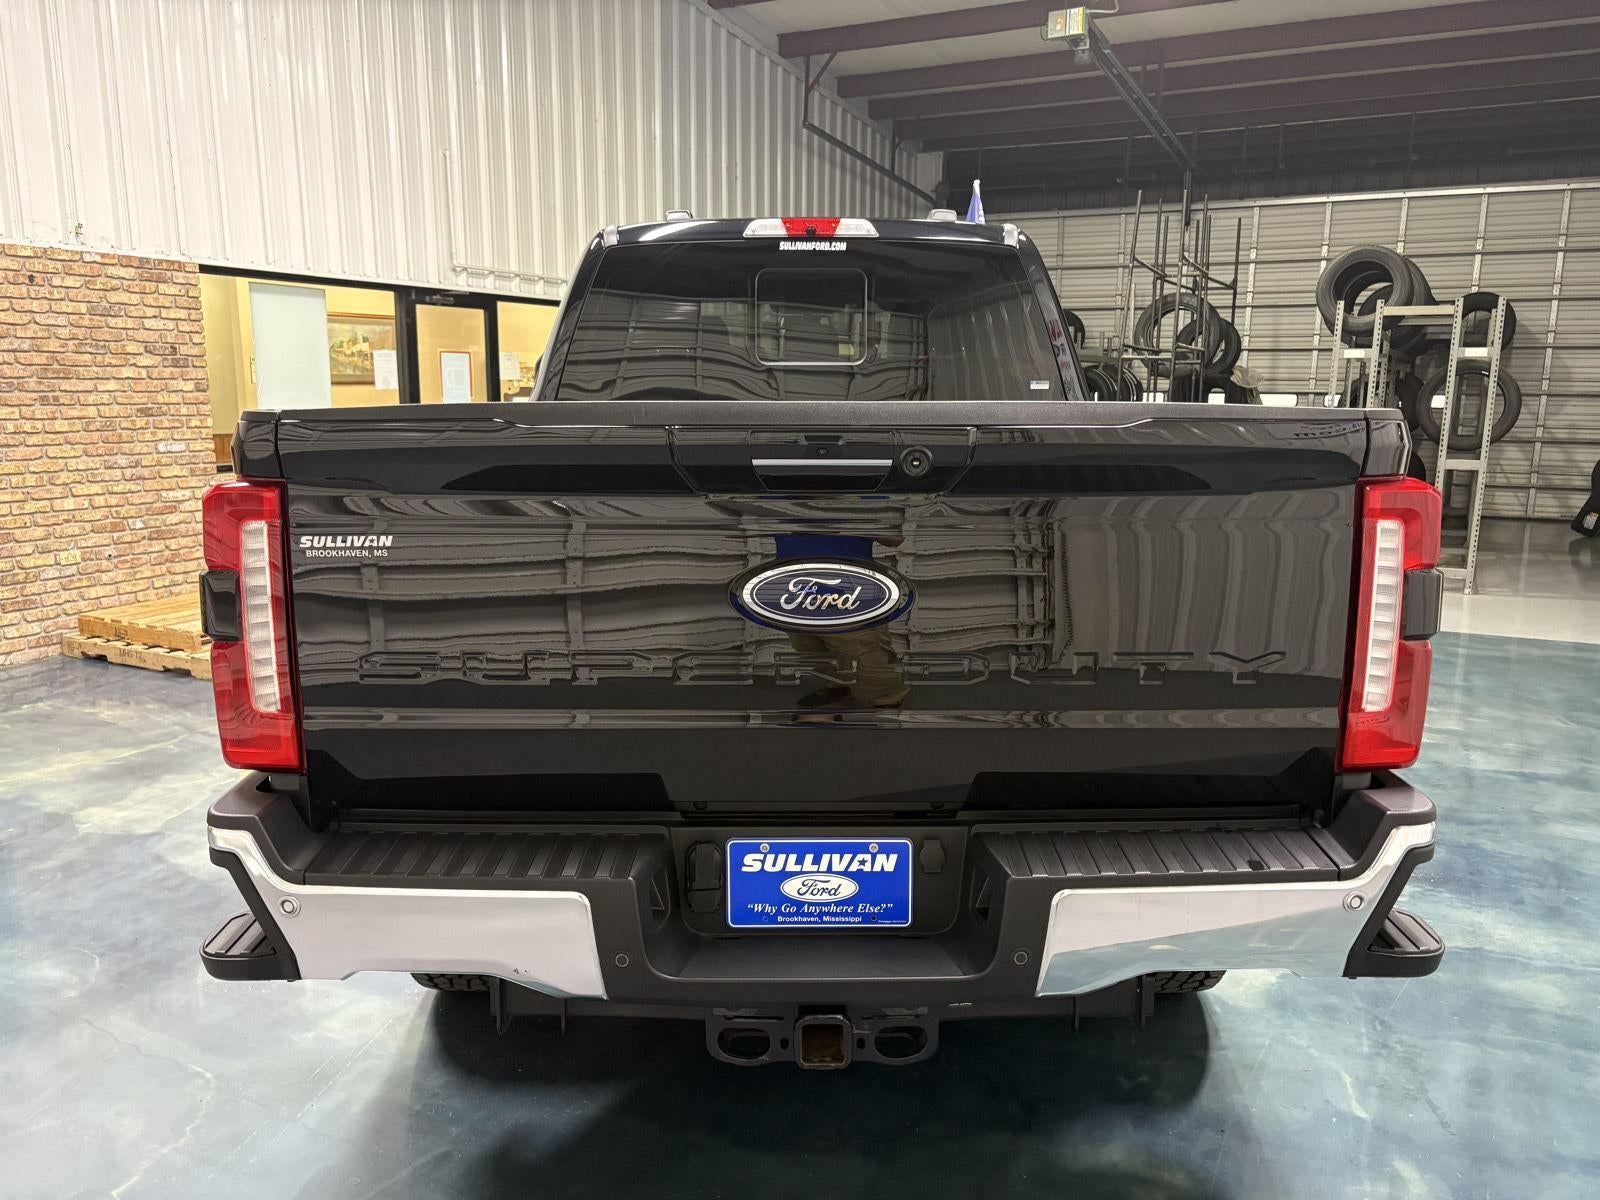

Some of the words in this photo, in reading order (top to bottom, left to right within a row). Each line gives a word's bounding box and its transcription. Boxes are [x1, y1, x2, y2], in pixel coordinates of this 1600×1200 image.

[779, 241, 847, 251] SULLIVANFORD.COM
[299, 535, 393, 548] SULLIVAN
[306, 549, 372, 558] BROOKHAVEN,
[374, 549, 388, 557] MS
[780, 576, 862, 611] Ford
[358, 650, 857, 686] SUPER
[903, 651, 1287, 685] DUTY
[741, 853, 898, 872] SULLIVAN
[797, 878, 841, 897] Ford
[747, 903, 778, 915] “Why
[781, 903, 797, 913] Go
[800, 903, 854, 915] Anywhere
[857, 903, 893, 913] Else?”
[777, 915, 821, 923] Brookhaven,
[822, 915, 862, 923] Mississippi
